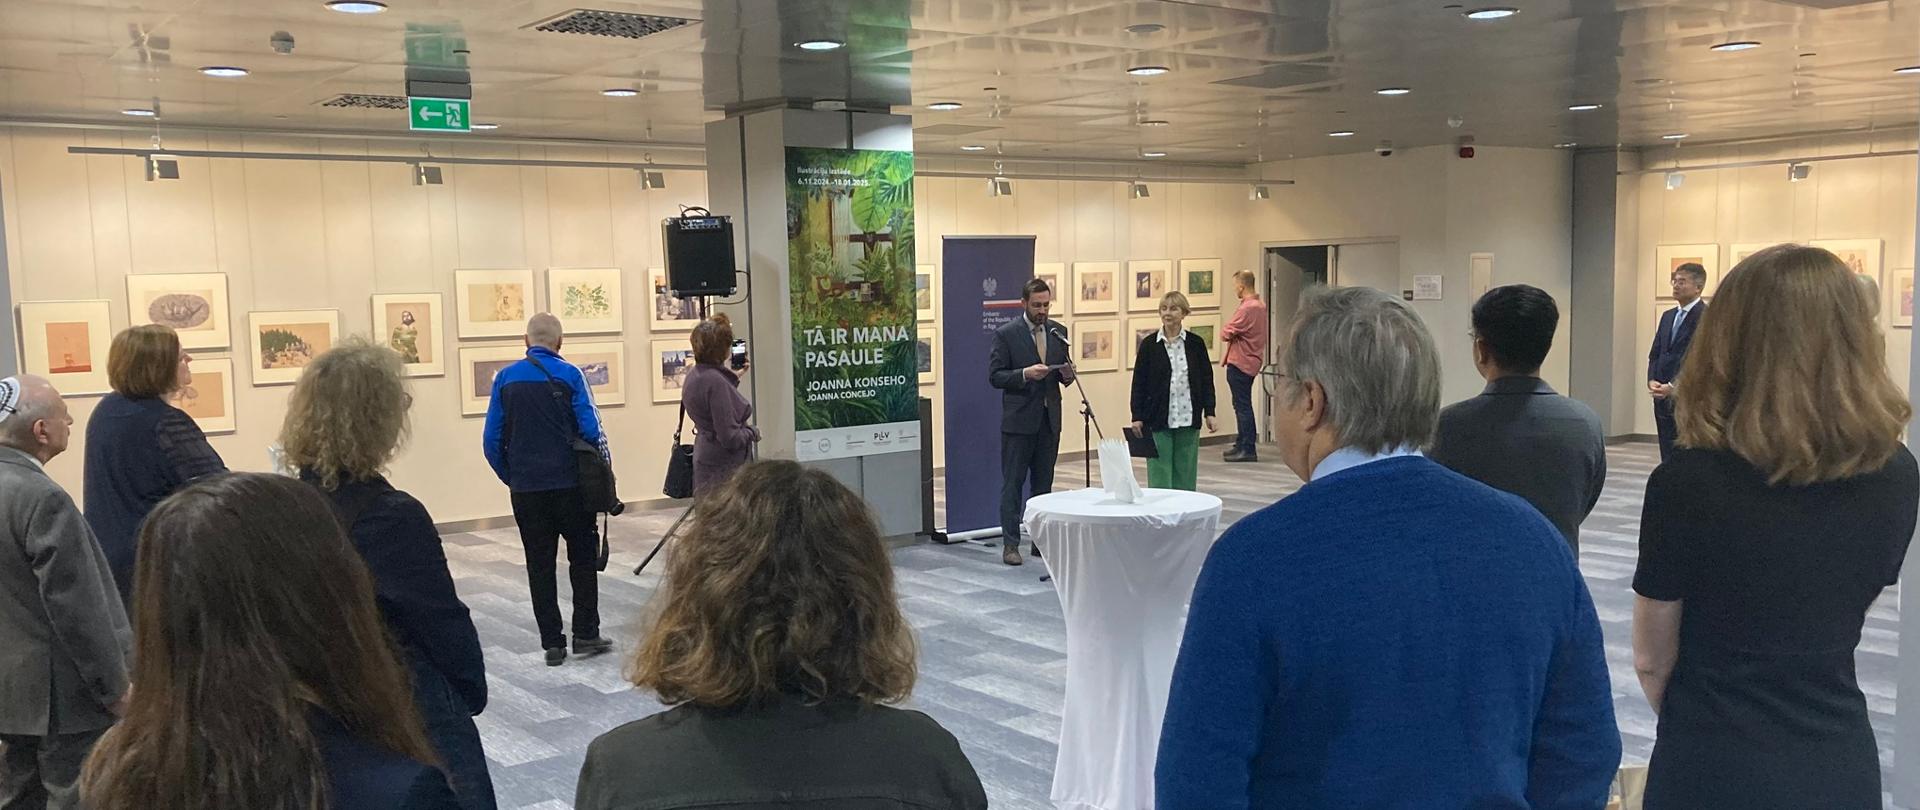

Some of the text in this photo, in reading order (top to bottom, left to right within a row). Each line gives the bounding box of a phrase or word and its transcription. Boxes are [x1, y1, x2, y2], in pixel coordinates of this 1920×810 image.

[804, 326, 909, 346] TĀ IR MANA
[805, 348, 884, 368] PASAULE
[806, 375, 906, 392] JOANNA KONSEHO
[807, 390, 876, 402] JOANNA CONCEJO
